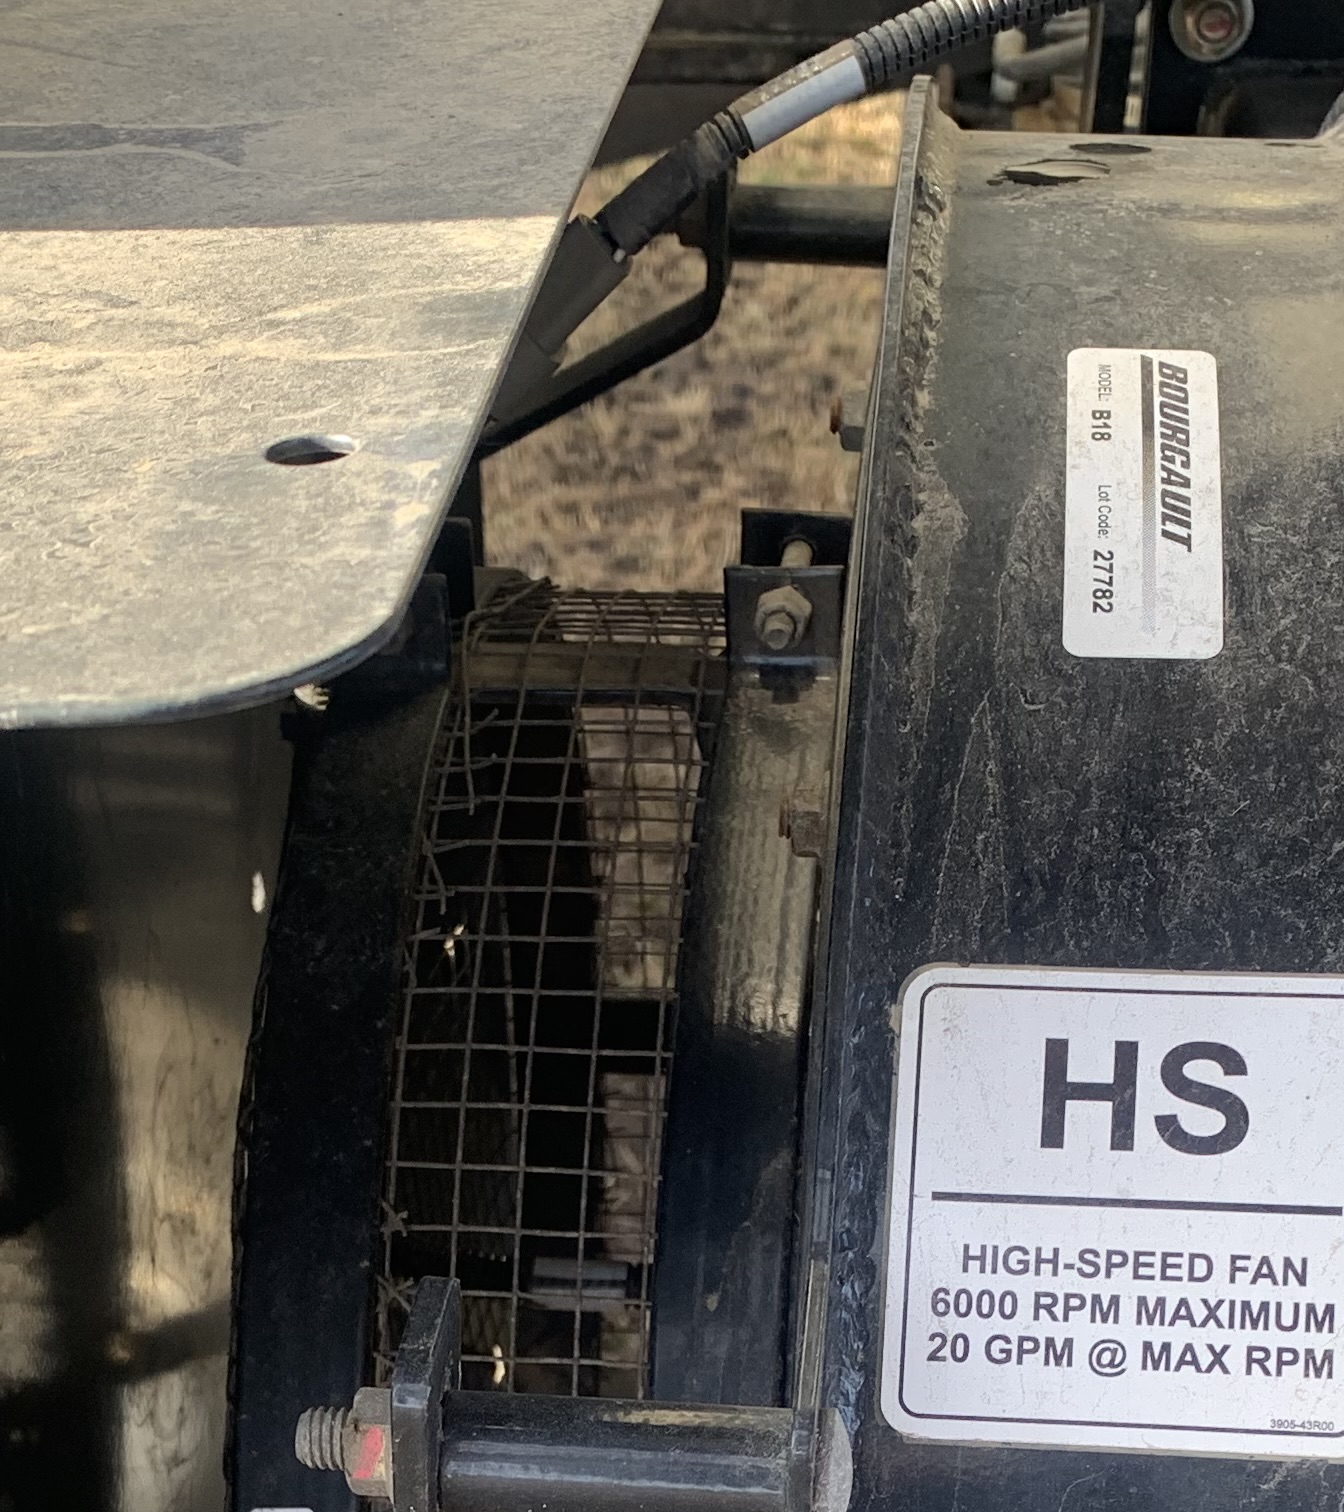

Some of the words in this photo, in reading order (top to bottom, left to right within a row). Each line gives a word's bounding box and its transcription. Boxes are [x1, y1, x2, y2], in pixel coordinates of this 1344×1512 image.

[1097, 363, 1112, 402] MODEL:
[1091, 408, 1112, 442] B18
[1158, 360, 1192, 553] BOURGAULT
[1097, 484, 1112, 502] Lot
[1097, 504, 1112, 539] Code:
[1092, 550, 1114, 614] 27782
[1039, 1037, 1251, 1155] HS
[960, 1243, 1215, 1284] HIGH-SPEED
[1228, 1254, 1309, 1287] FAN
[930, 1286, 1019, 1320] 6000
[1032, 1292, 1120, 1325] RPM
[1135, 1296, 1336, 1334] MAXIMUM
[926, 1332, 971, 1363] 20
[984, 1333, 1074, 1368] GPM
[1088, 1338, 1128, 1378] @
[1141, 1341, 1232, 1376] MAX
[1245, 1344, 1335, 1380] RPM
[1269, 1418, 1336, 1432] 3905-43R00
